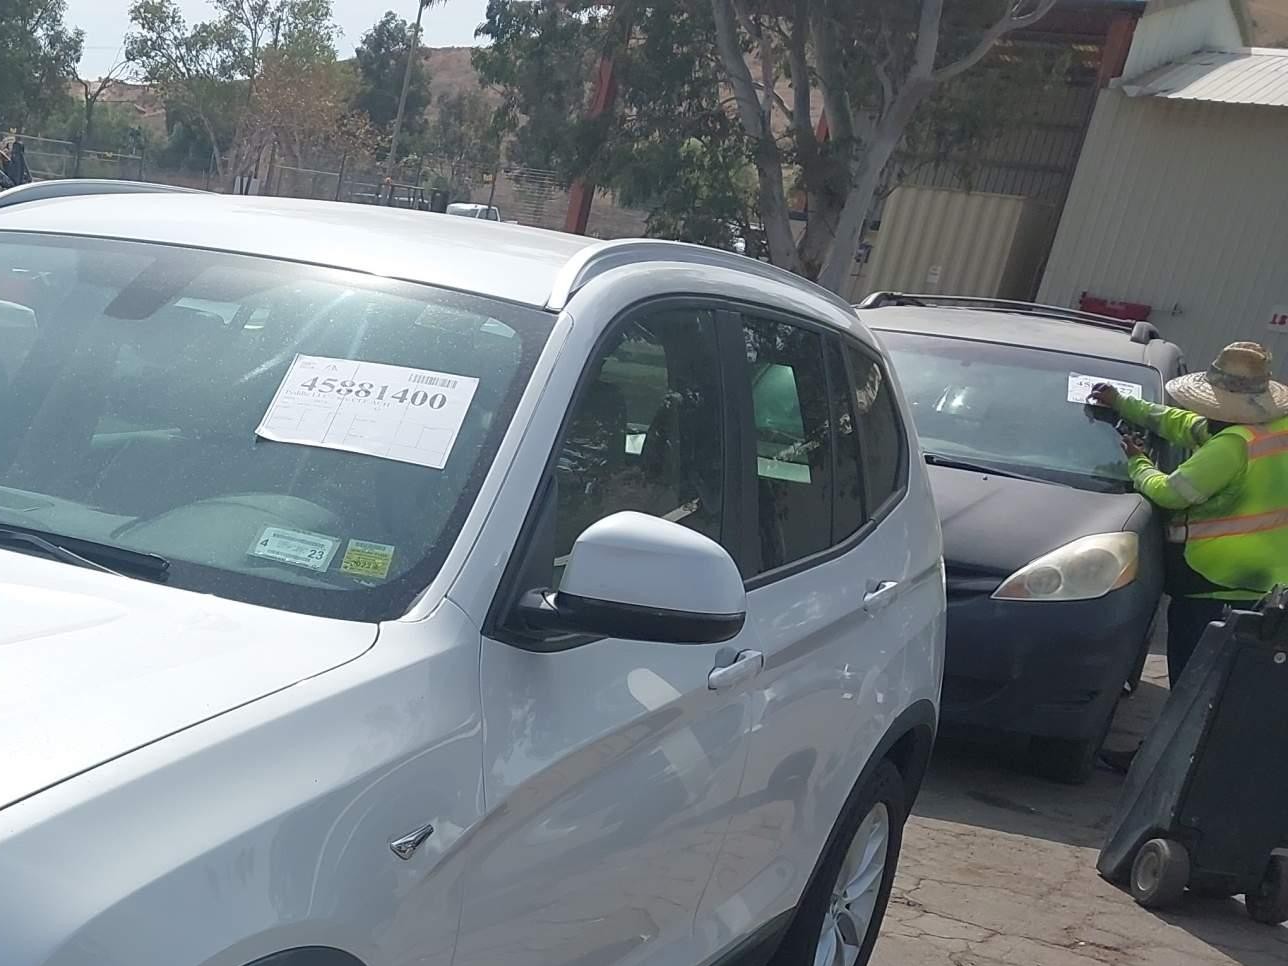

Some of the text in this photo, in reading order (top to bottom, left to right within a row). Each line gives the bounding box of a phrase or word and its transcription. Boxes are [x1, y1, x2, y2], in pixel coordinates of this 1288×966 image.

[301, 376, 447, 409] 45881400
[260, 539, 269, 547] 4
[308, 549, 325, 560] 23
